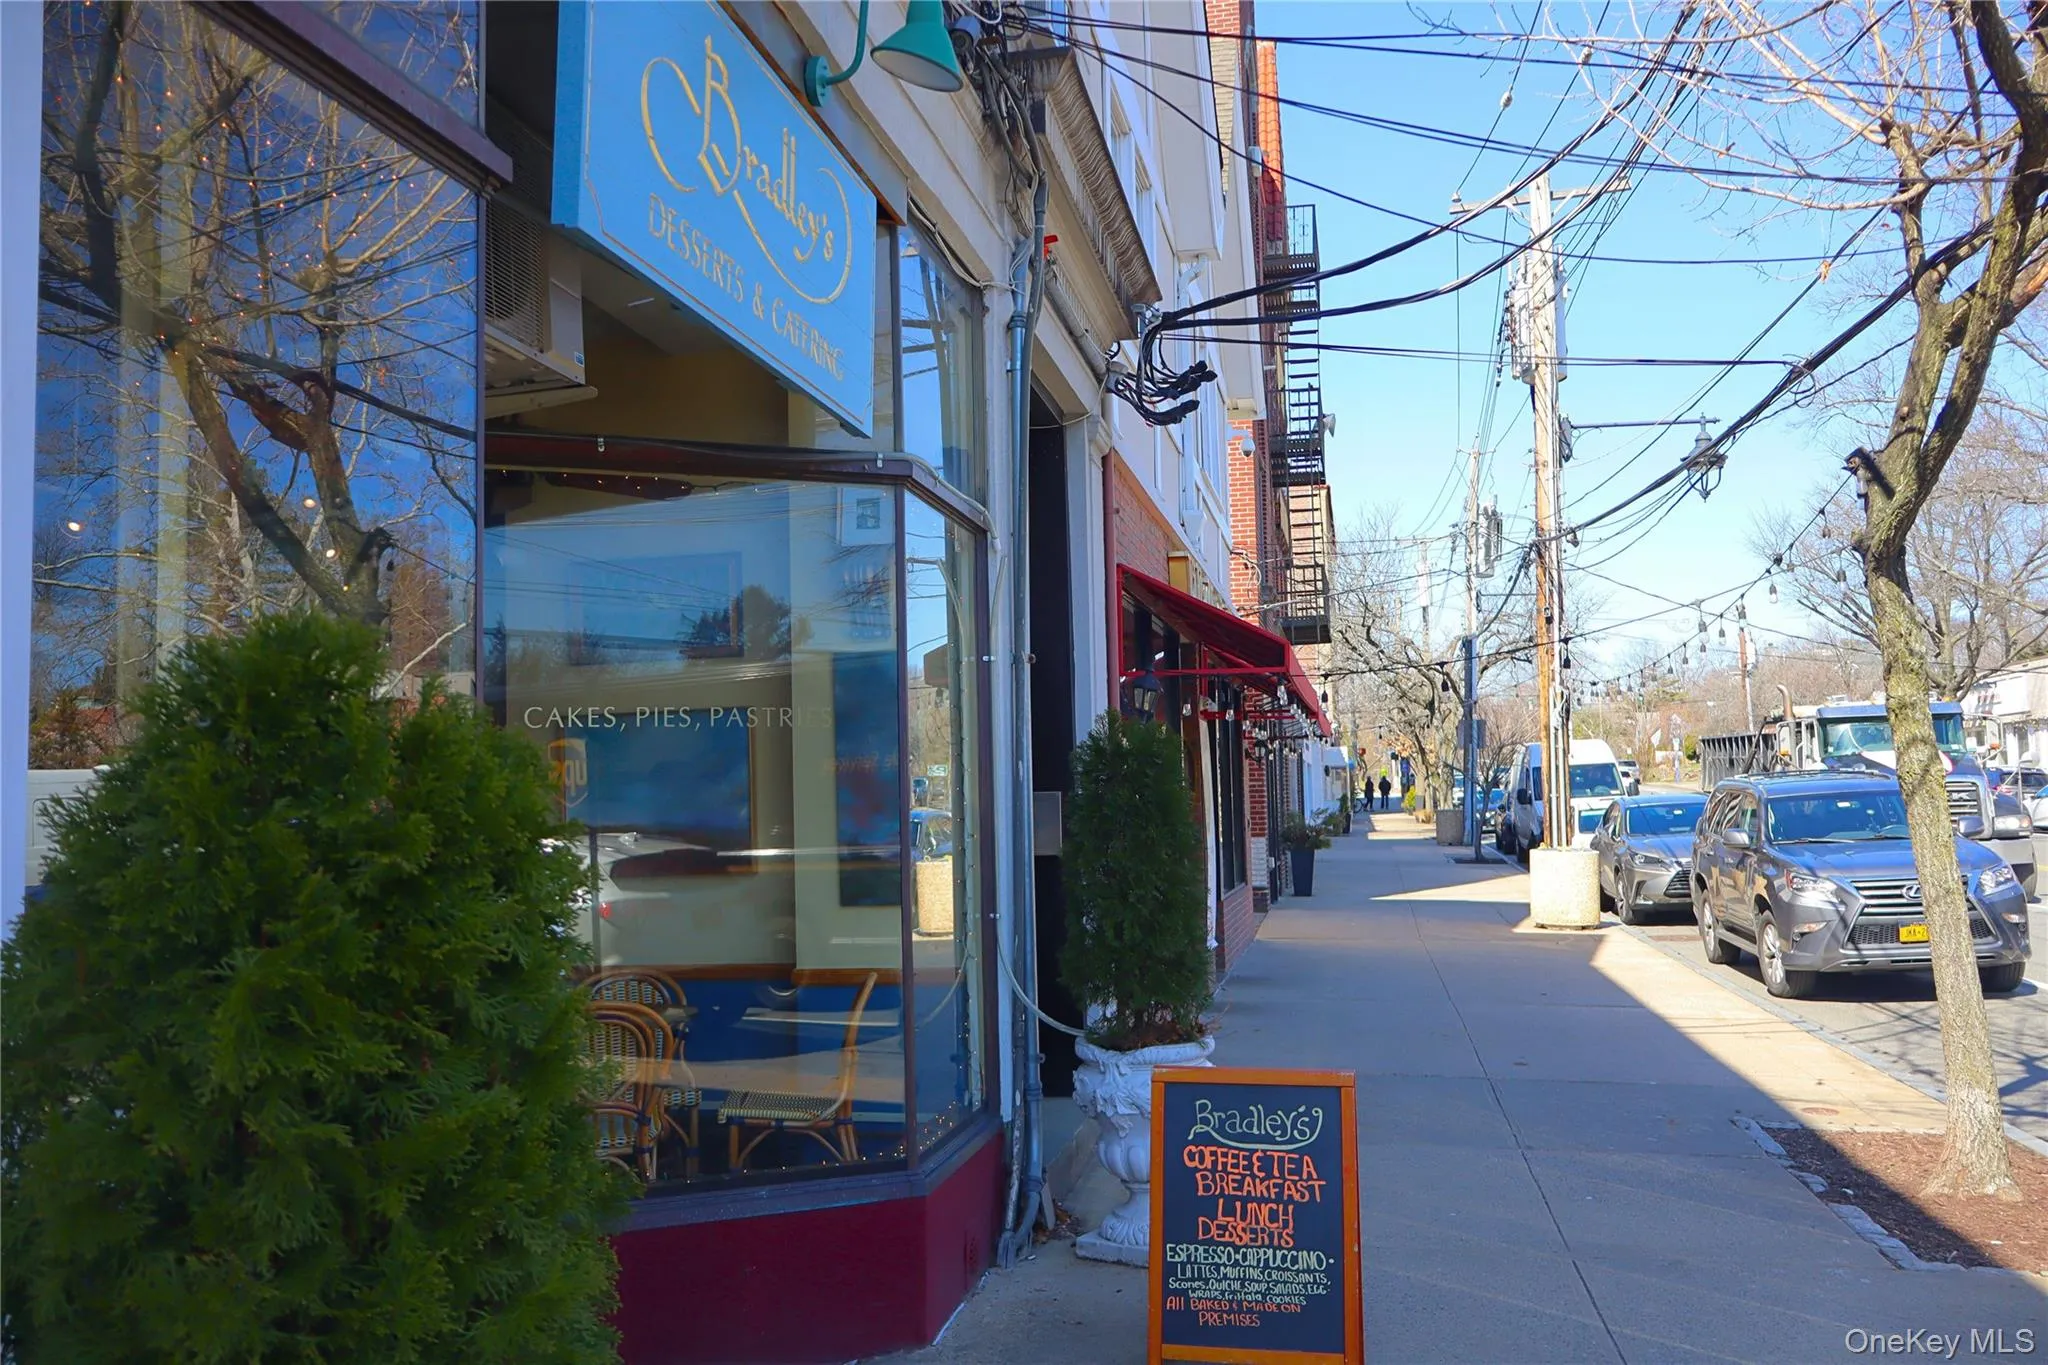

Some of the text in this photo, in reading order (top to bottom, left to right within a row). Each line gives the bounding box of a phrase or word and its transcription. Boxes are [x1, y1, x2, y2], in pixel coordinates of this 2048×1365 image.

[641, 35, 836, 262] Bradley's
[649, 192, 844, 382] DESSERTS & CATERING
[523, 706, 834, 732] CAKES, PIES, PASTRIES
[1193, 1099, 1312, 1142] Bradley's
[1183, 1145, 1318, 1180] COFFEE & TEA
[1195, 1171, 1326, 1203] BREAKFAST
[1217, 1197, 1294, 1231] LUNCH
[1198, 1217, 1295, 1248] DESSERTS
[1190, 1298, 1229, 1310] BAKED
[1242, 1301, 1279, 1312] MADE
[1280, 1304, 1301, 1313] ON
[1266, 1295, 1307, 1305] COOKIES
[1198, 1311, 1261, 1327] PREMISES
